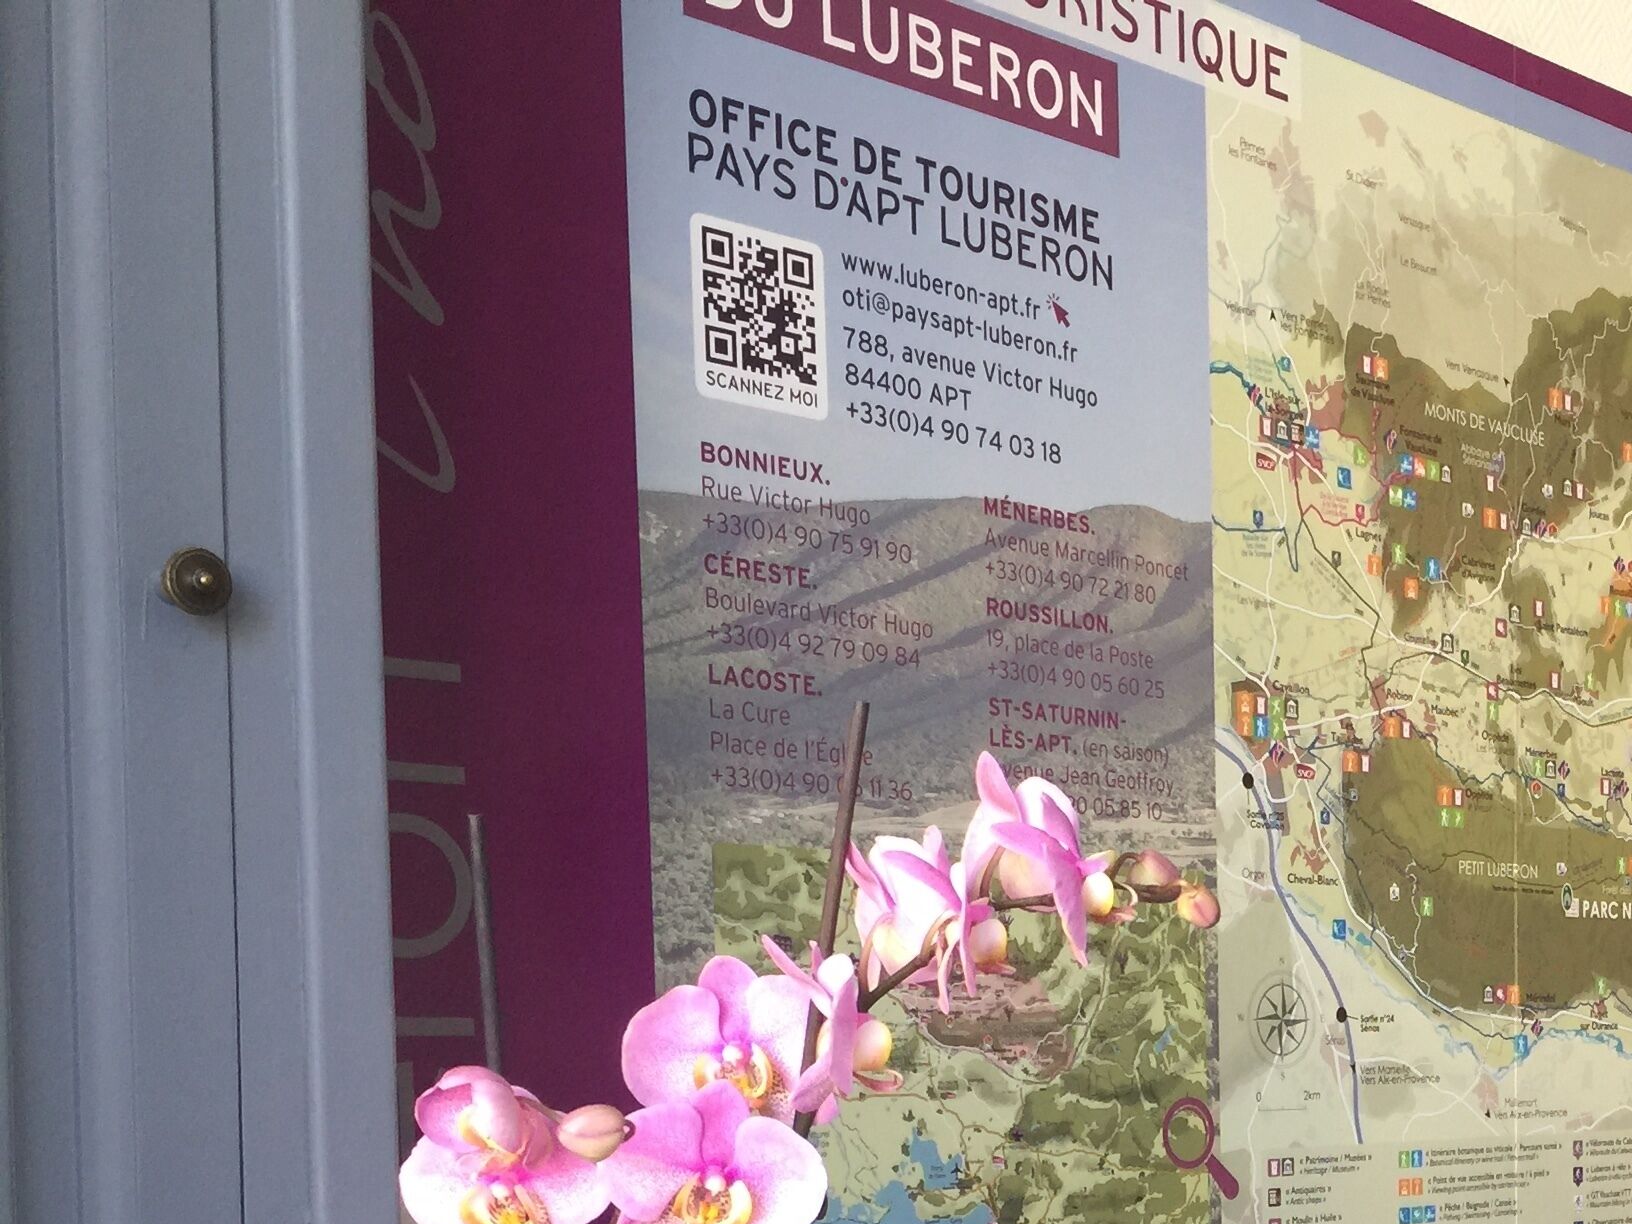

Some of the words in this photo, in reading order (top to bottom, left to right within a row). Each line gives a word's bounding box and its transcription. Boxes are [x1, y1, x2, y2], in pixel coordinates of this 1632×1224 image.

[822, 0, 1103, 136] LUBERON
[689, 88, 838, 166] OFFICE
[853, 136, 902, 185] DE
[915, 156, 1100, 244] TOURISME
[688, 131, 796, 200] PAYS
[941, 206, 1113, 290] LUBERON
[841, 252, 1041, 319] www.luberon-apt.fr
[842, 287, 1078, 362] oti@paysapt-luberon.fr
[706, 370, 784, 400] SCANNEZ
[790, 388, 818, 408] MOI
[843, 326, 895, 362] 788,
[902, 346, 976, 378] avenue
[983, 360, 1043, 393] Victor
[1049, 376, 1098, 409] Hugo
[845, 363, 921, 399] 84400
[929, 383, 971, 411] APT
[847, 402, 934, 437] +33(0)4
[942, 420, 968, 444] 90
[976, 427, 1002, 451] 74
[1009, 435, 1034, 458] 03
[1041, 440, 1061, 464] 18
[1424, 401, 1466, 427] MONTS
[1469, 413, 1485, 431] DE
[1488, 418, 1545, 447] VAUCLUSE
[700, 441, 831, 486] BONNIEUX.
[702, 475, 742, 500] Rue
[750, 484, 812, 514] Victor
[820, 498, 871, 528] Hugo
[984, 495, 1096, 535] MÉNERBES.
[702, 512, 787, 544] +33(0)4
[795, 526, 822, 550] 90
[829, 531, 853, 554] 75
[860, 537, 880, 560] 91
[886, 541, 912, 564] 90
[985, 528, 1049, 557] Avenue
[1056, 540, 1129, 571] Marcellin
[1135, 555, 1189, 582] Poncet
[704, 550, 818, 590] CÉRESTE.
[985, 560, 1055, 588] +33(0)4
[1061, 572, 1083, 592] 90
[1089, 576, 1109, 597] 72
[1114, 580, 1129, 600] 21
[1134, 584, 1156, 604] 80
[706, 586, 811, 622] Boulevard
[818, 603, 877, 629] Victor
[884, 613, 933, 641] Hugo
[986, 596, 1114, 634] ROUSSILLON.
[706, 622, 791, 651] +33(0)4
[798, 633, 824, 656] 92
[830, 638, 855, 660] 79
[862, 642, 888, 663] 09
[895, 646, 920, 669] 84
[1015, 634, 1059, 656] place
[1065, 640, 1084, 660] de
[1090, 643, 1103, 663] la
[1109, 646, 1153, 669] Poste
[708, 663, 823, 697] LACOSTE.
[988, 660, 1056, 686] +33(0)4
[1063, 669, 1085, 688] 90
[1091, 672, 1112, 693] 05
[1118, 676, 1139, 696] 60
[1145, 680, 1164, 699] 25
[709, 698, 734, 720] La
[742, 701, 791, 726] Cure
[989, 697, 1126, 729] ST-SATURNIN-
[710, 731, 766, 756] Place
[774, 738, 798, 759] de
[805, 737, 873, 767] l'Égle
[989, 724, 1077, 756] LÈS-APT.
[1113, 743, 1169, 769] saison)
[711, 766, 796, 792] +33(0)4
[802, 773, 829, 794] 90
[888, 780, 913, 801] 36
[1060, 766, 1099, 786] Jean
[1106, 769, 1174, 797] Geoffroy
[1287, 872, 1339, 887] Cheval-Blanc
[1458, 859, 1484, 875] PETIT
[1487, 861, 1538, 879] LUBERON
[1582, 900, 1618, 920] PARC
